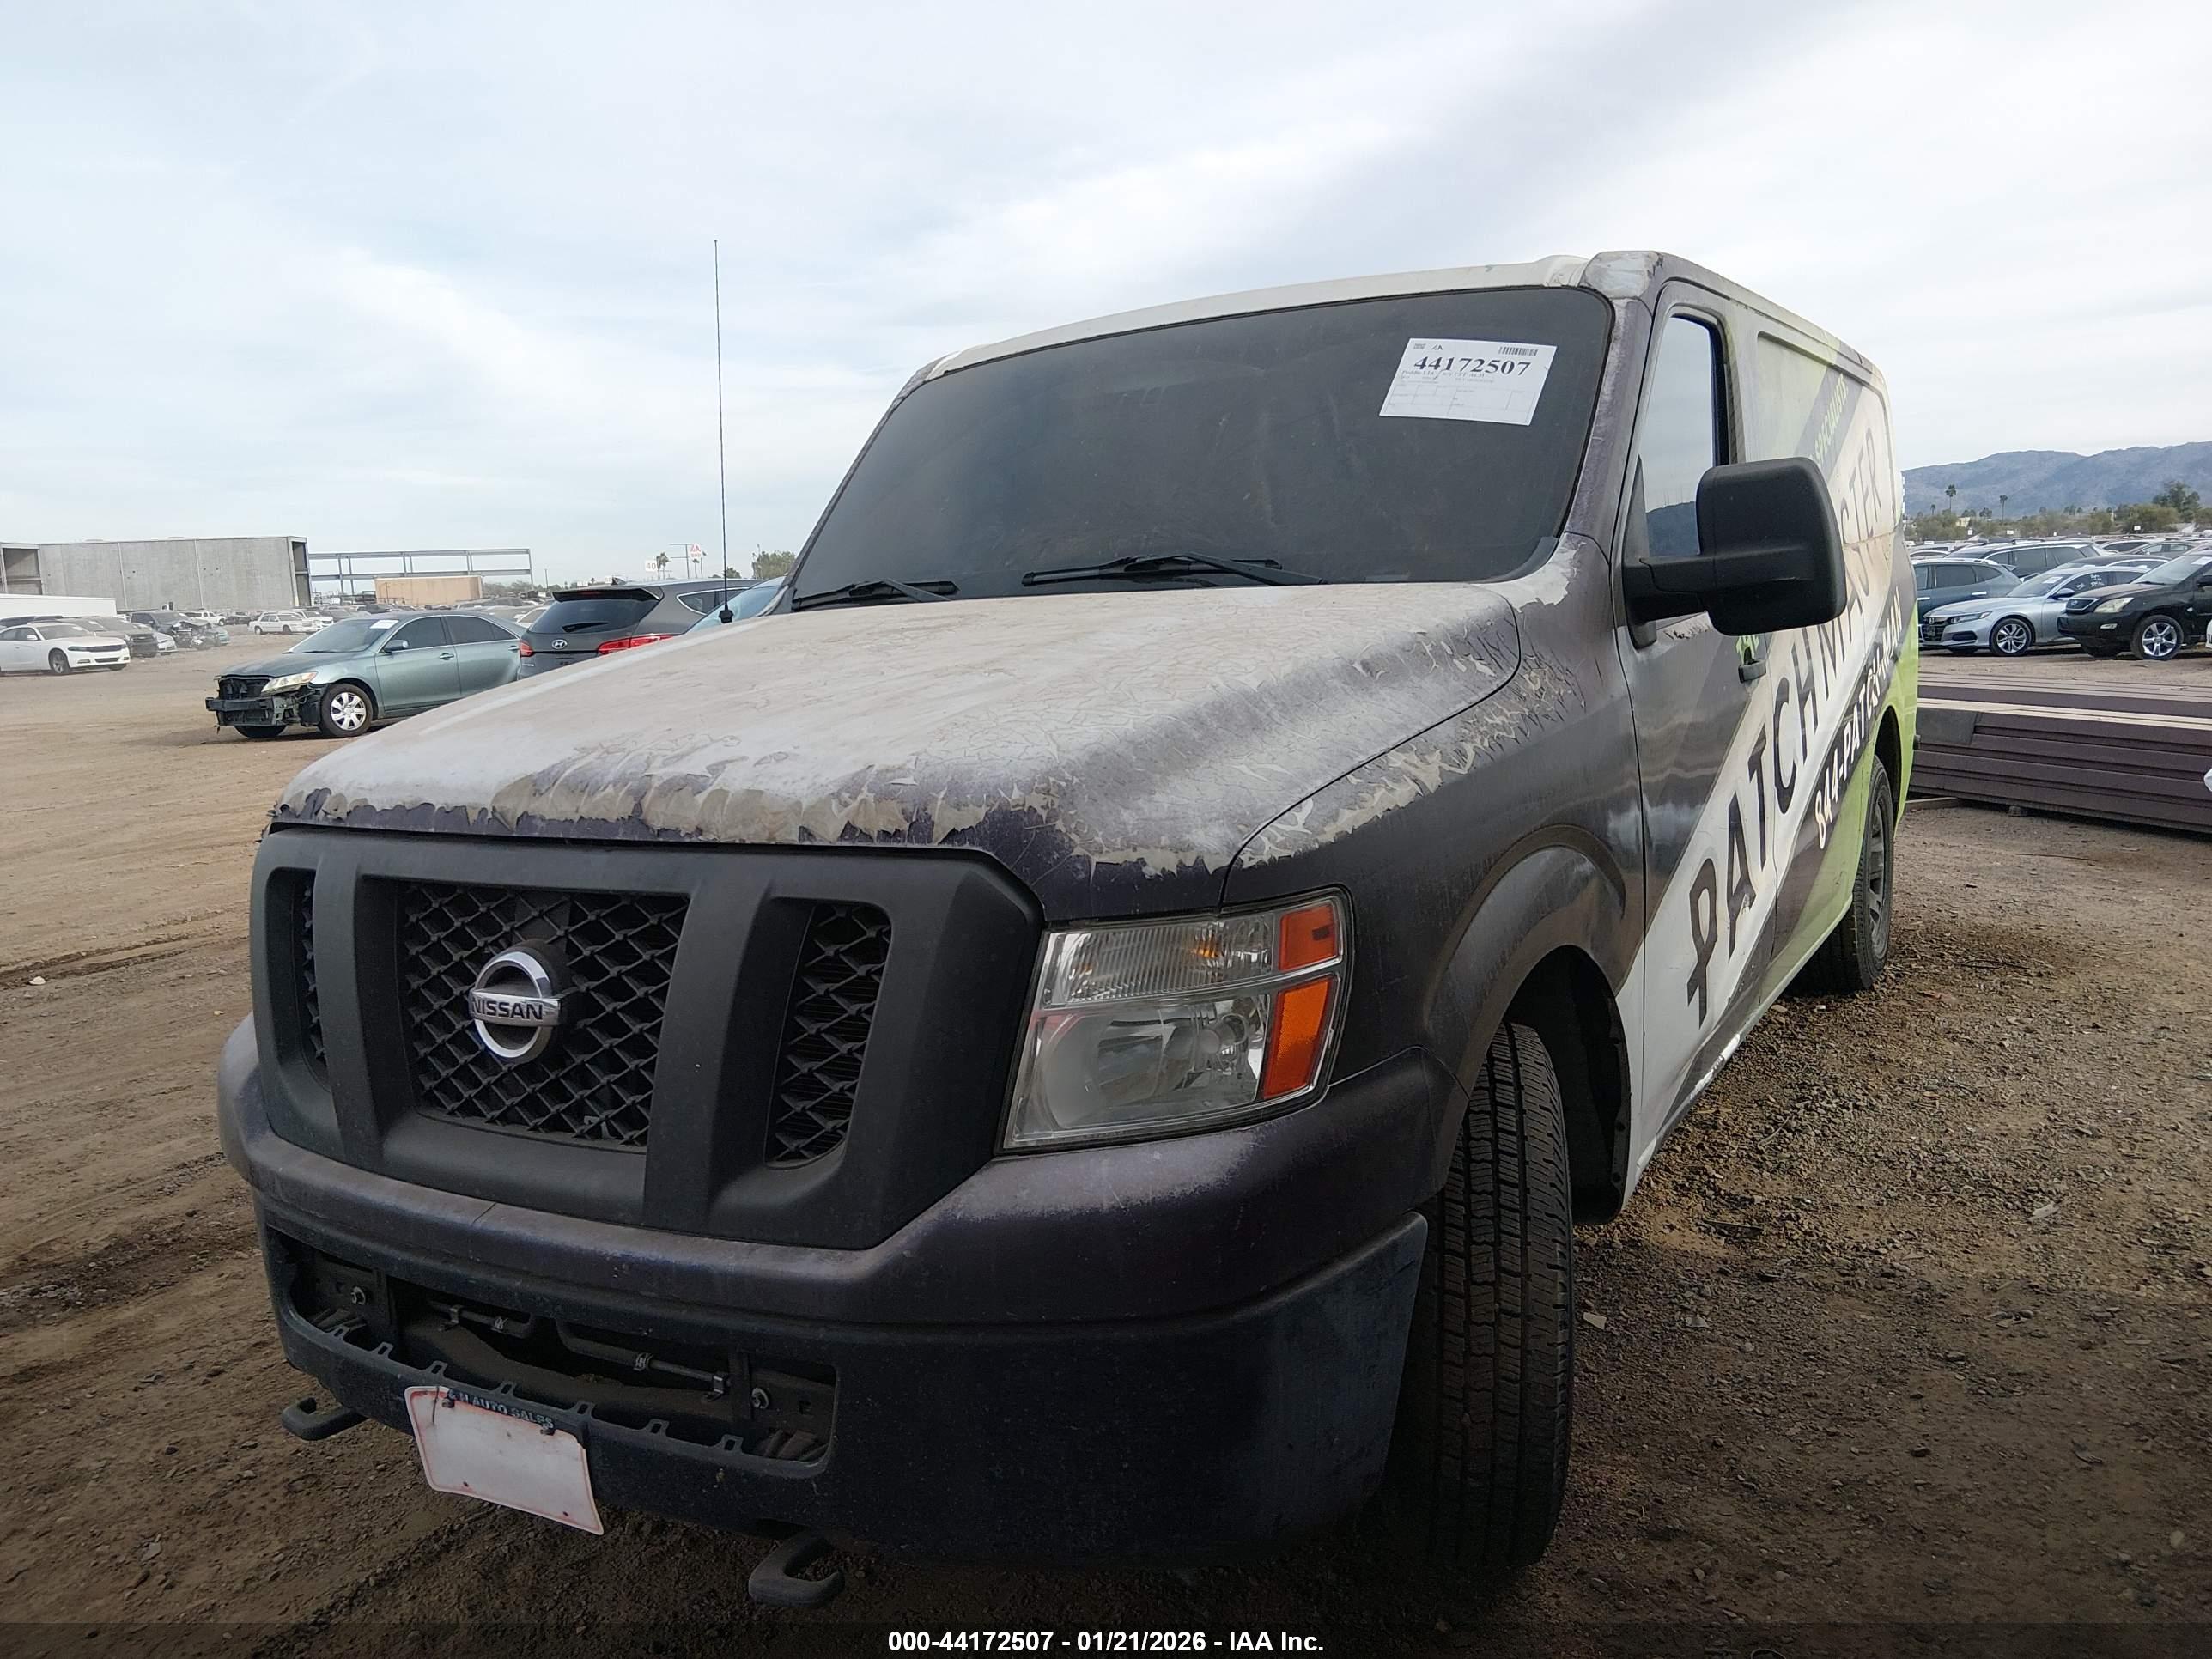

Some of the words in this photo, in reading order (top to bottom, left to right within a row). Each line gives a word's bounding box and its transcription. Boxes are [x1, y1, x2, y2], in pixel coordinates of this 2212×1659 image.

[1413, 356, 1531, 375] 44172507
[1814, 586, 1903, 849] 844-PATCH-MAN
[471, 998, 544, 1020] NISSAN
[472, 1396, 508, 1416] AUTO
[511, 1409, 554, 1430] SALES
